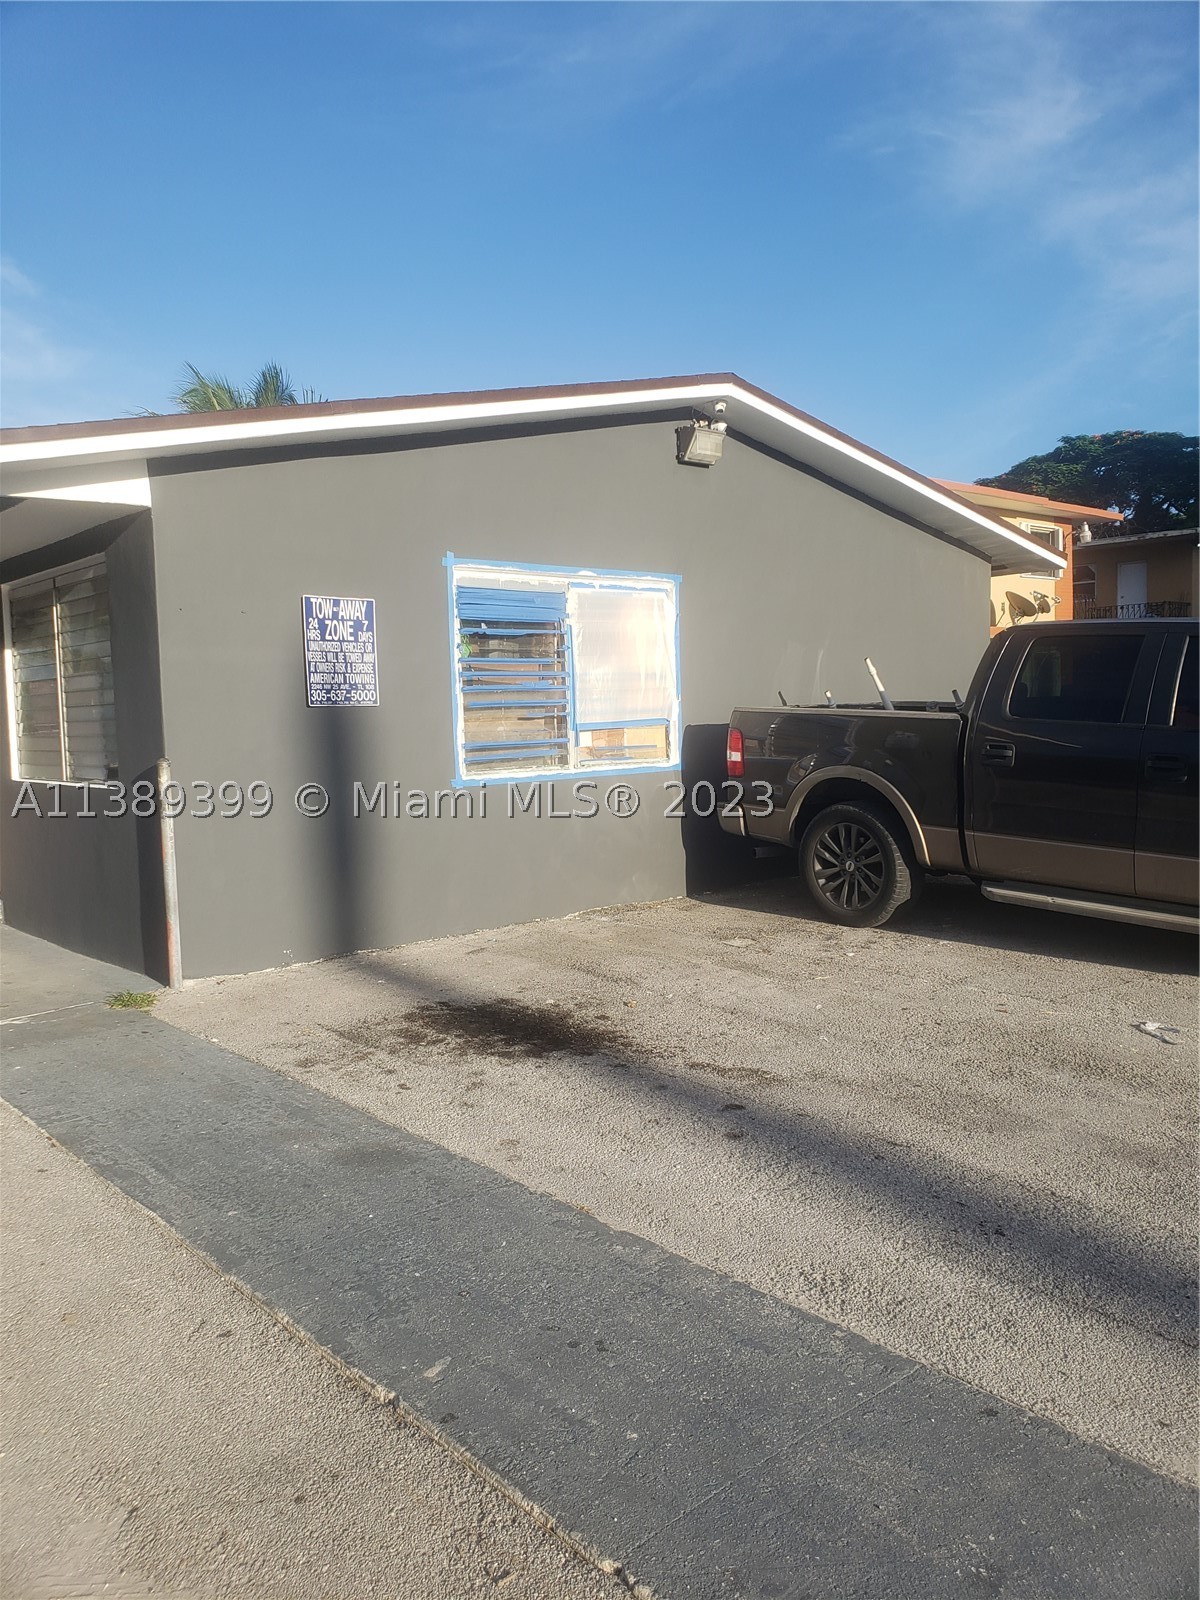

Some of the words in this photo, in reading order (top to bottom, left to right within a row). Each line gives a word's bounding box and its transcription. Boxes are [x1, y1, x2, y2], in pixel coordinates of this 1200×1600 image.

[310, 597, 367, 620] TOW-AWAY
[308, 618, 319, 629] 24
[361, 621, 368, 631] 7
[307, 629, 321, 641] HRS
[324, 620, 354, 641] ZONE
[358, 631, 373, 642] DAYS
[308, 641, 341, 652] UNAUTHORIZED
[341, 642, 364, 652] VEHICLES
[365, 643, 372, 652] OR
[308, 651, 326, 662] VESSELS
[327, 652, 337, 662] WILL
[338, 652, 345, 662] BE
[345, 653, 362, 663] TOWED
[310, 662, 315, 672] AT
[335, 663, 346, 672] RISK
[347, 663, 351, 673] &
[352, 663, 374, 673] EXPENSE
[310, 673, 343, 683] AMERICAN
[345, 673, 375, 684] TOWING
[311, 690, 376, 701] 305-637-5000
